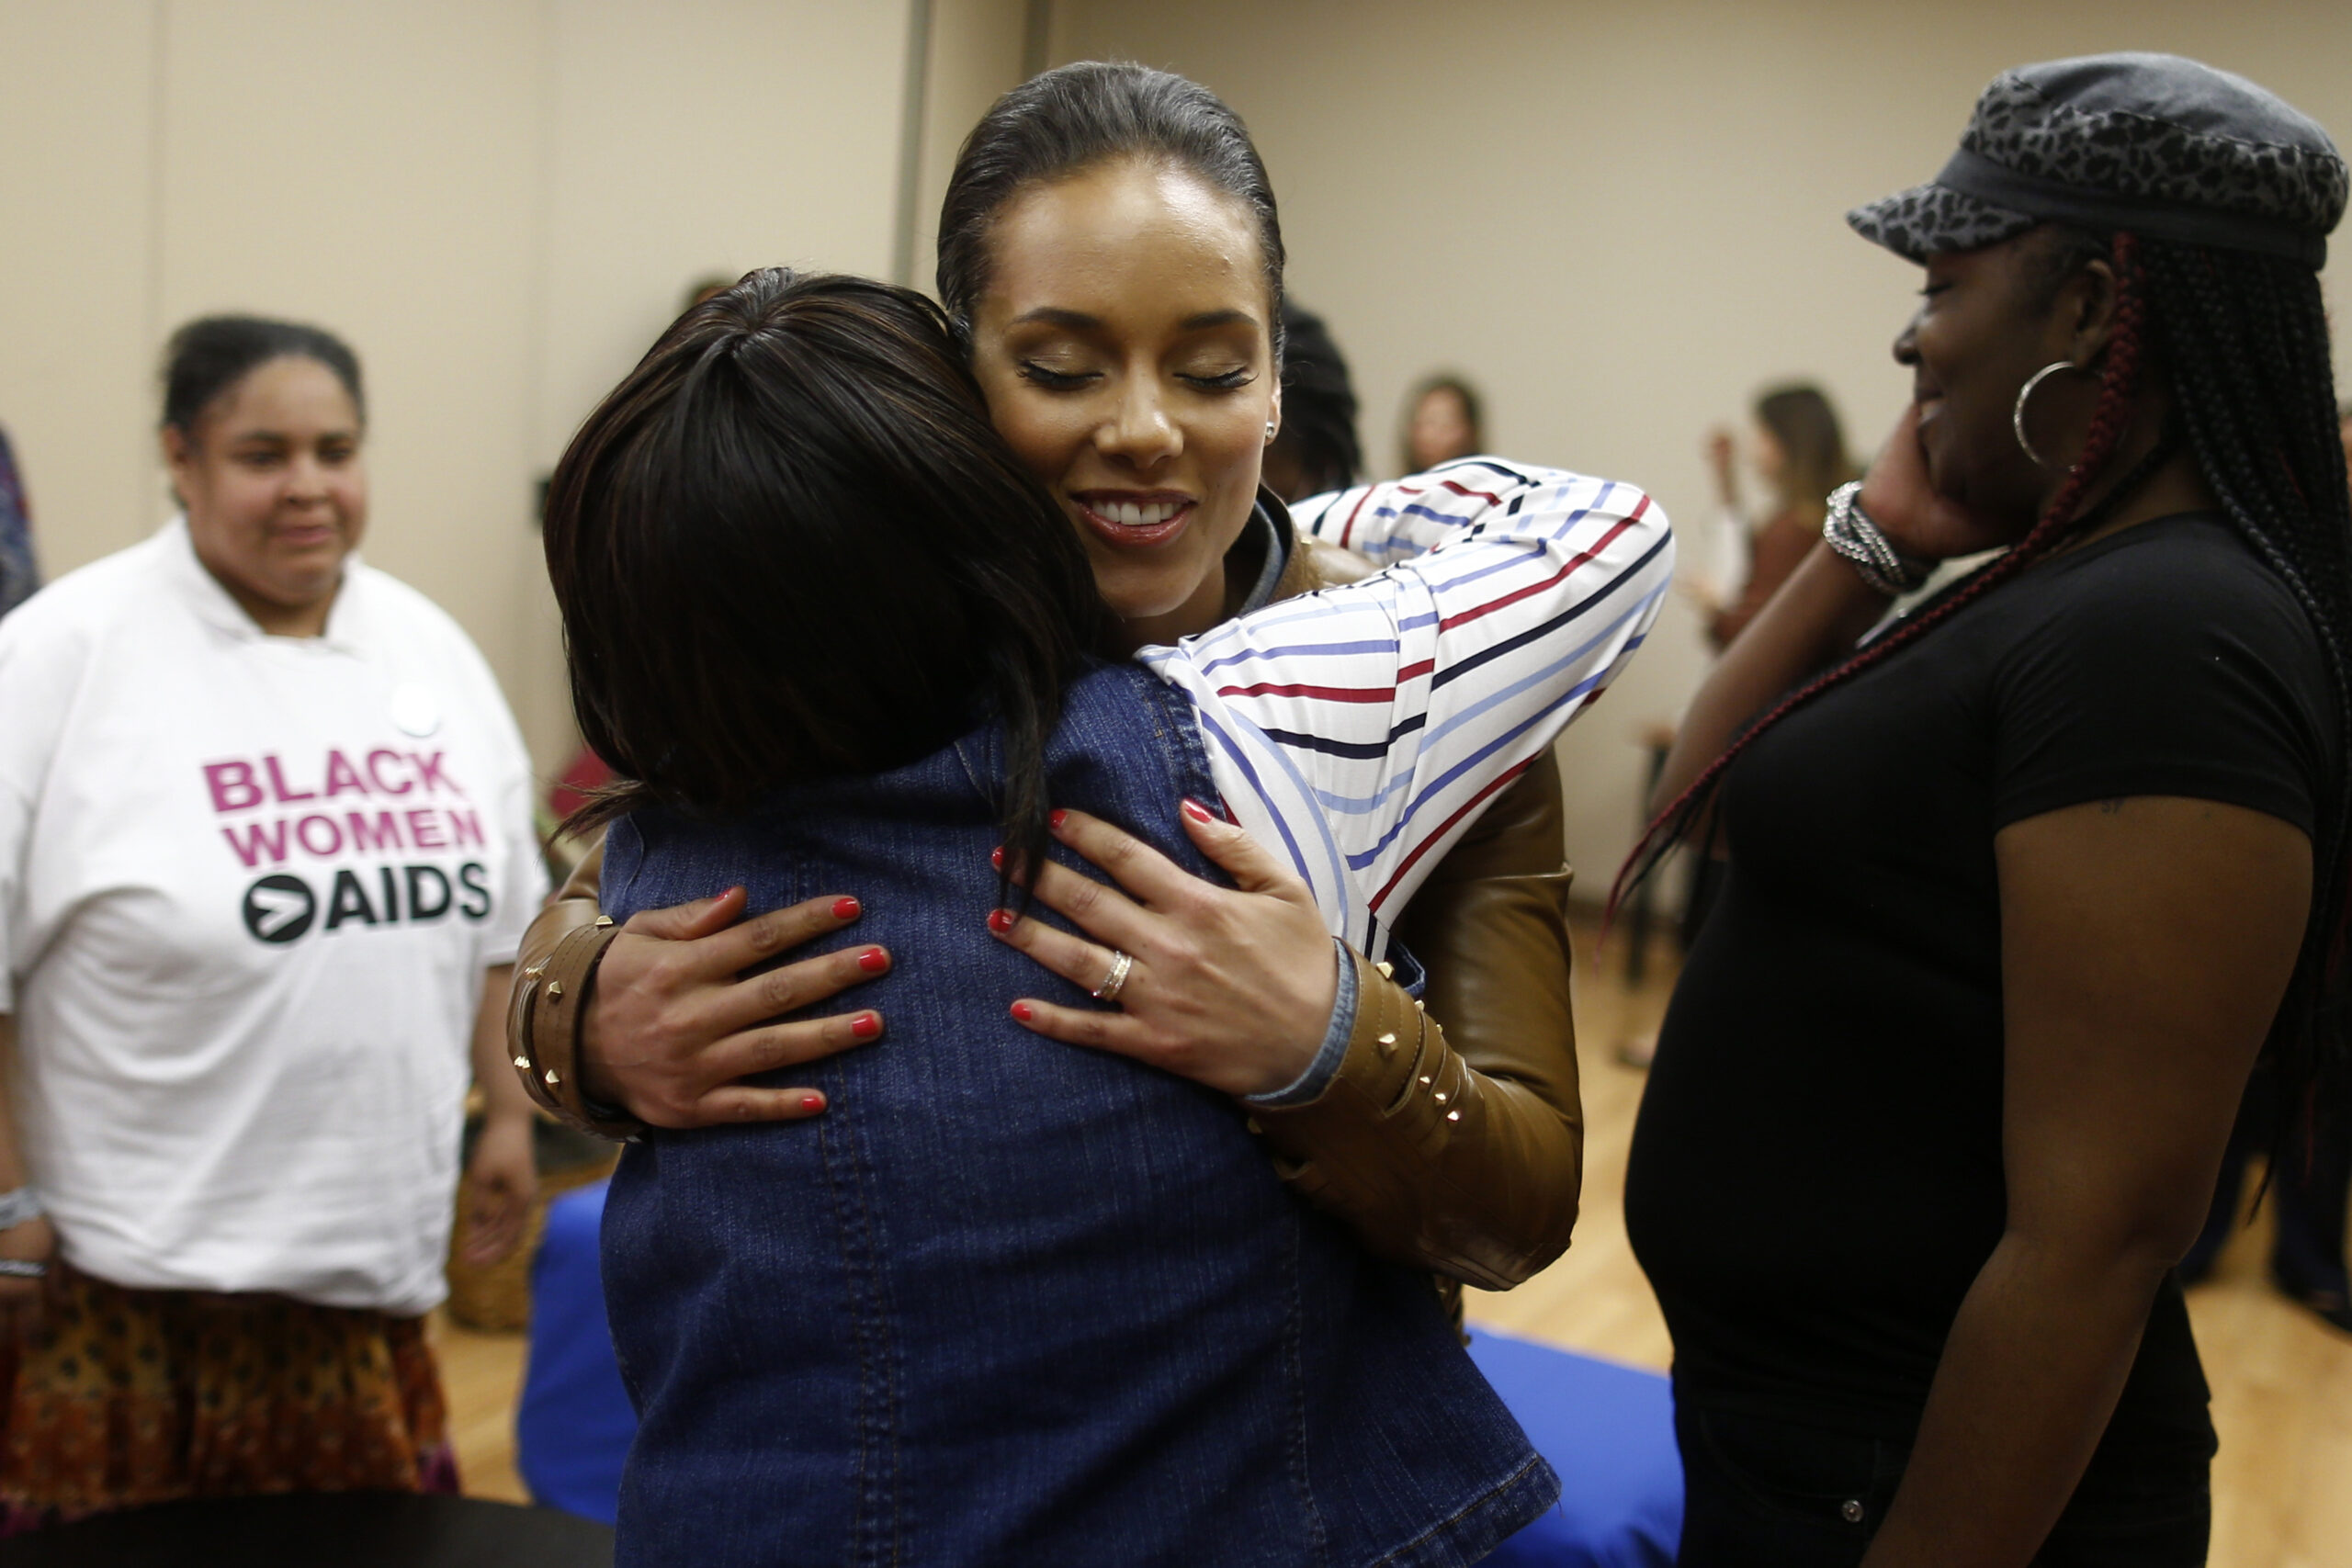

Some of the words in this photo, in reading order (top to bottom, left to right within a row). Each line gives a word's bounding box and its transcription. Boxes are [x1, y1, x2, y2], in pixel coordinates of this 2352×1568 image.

[203, 749, 463, 813] BLACK
[221, 809, 486, 868] WOMEN
[324, 862, 492, 931] AIDS
